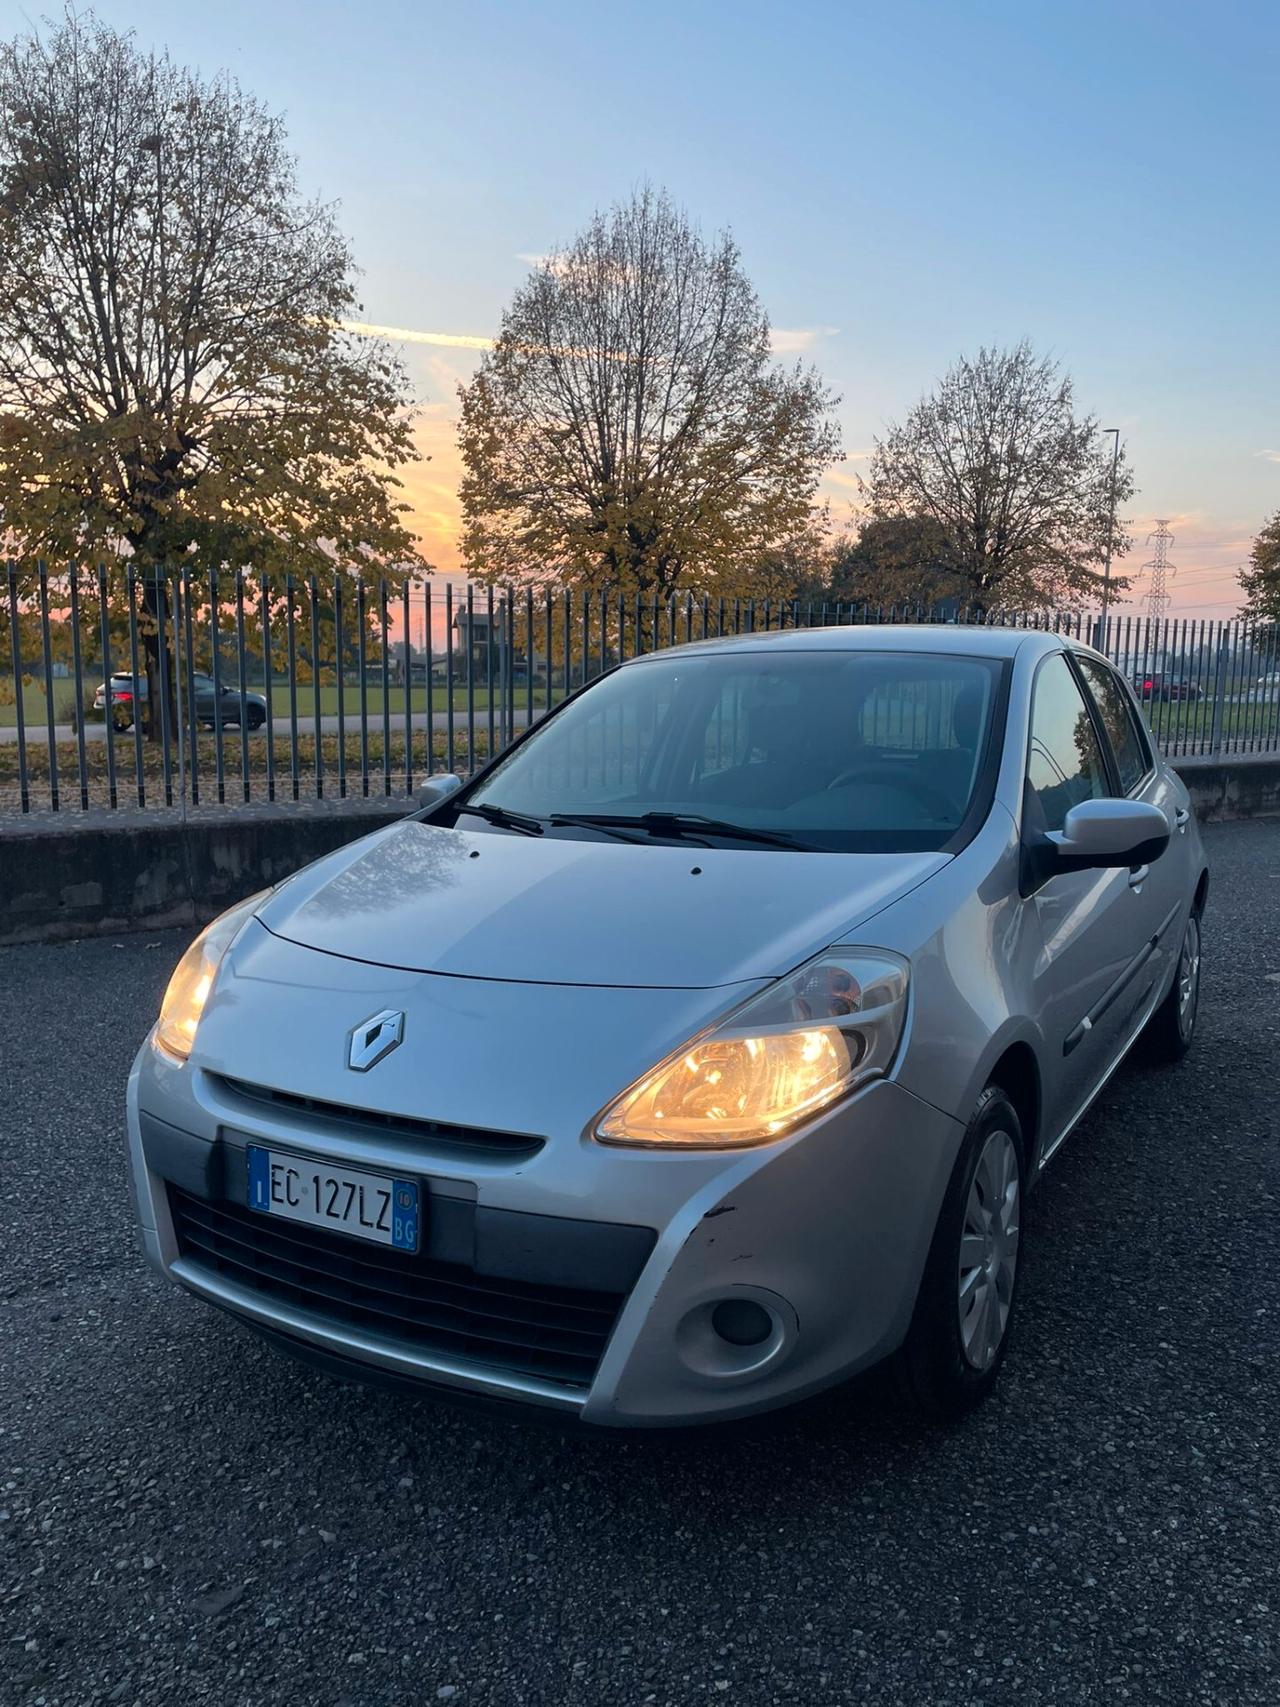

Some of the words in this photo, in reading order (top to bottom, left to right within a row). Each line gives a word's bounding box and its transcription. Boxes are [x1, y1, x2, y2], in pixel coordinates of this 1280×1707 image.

[271, 1164, 299, 1207] EC
[312, 1175, 390, 1232] 127LZ
[395, 1216, 414, 1243] BG
